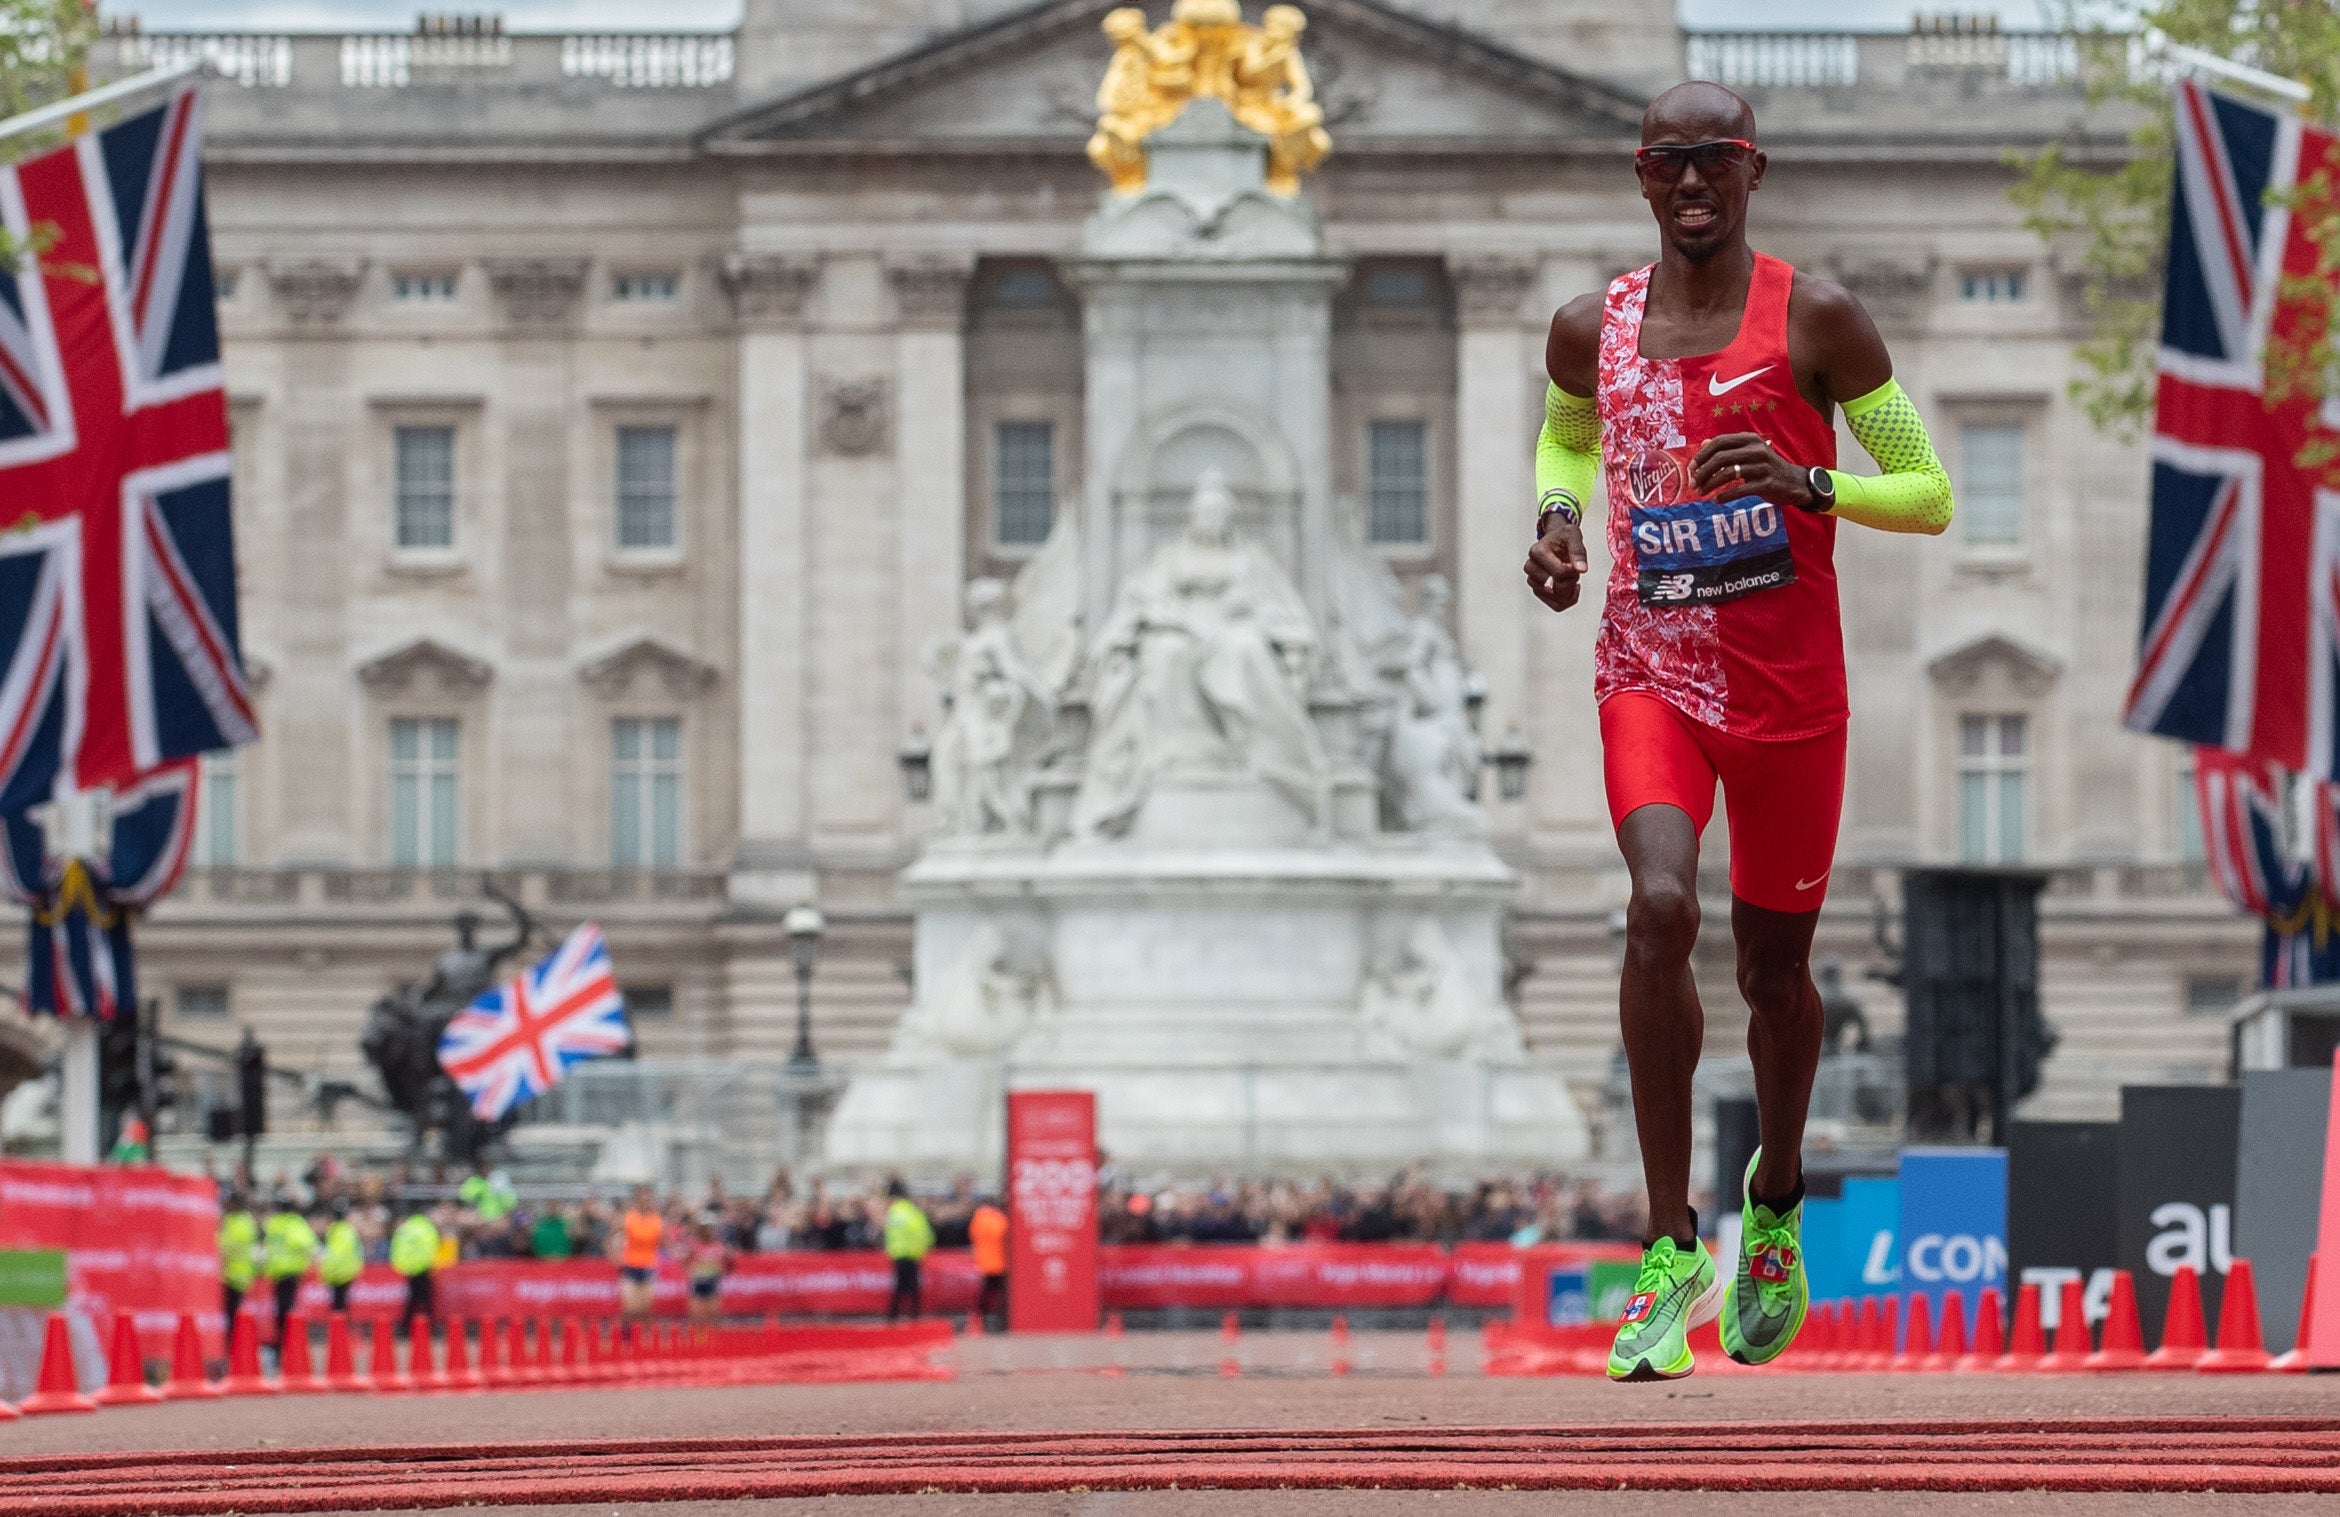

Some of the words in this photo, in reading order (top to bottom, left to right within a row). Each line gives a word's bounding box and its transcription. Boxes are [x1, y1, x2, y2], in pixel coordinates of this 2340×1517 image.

[1633, 452, 1676, 503] Virgin
[1638, 518, 1702, 554] SIR
[1712, 501, 1777, 548] MO
[1697, 584, 1722, 598] new
[1725, 570, 1780, 594] balance
